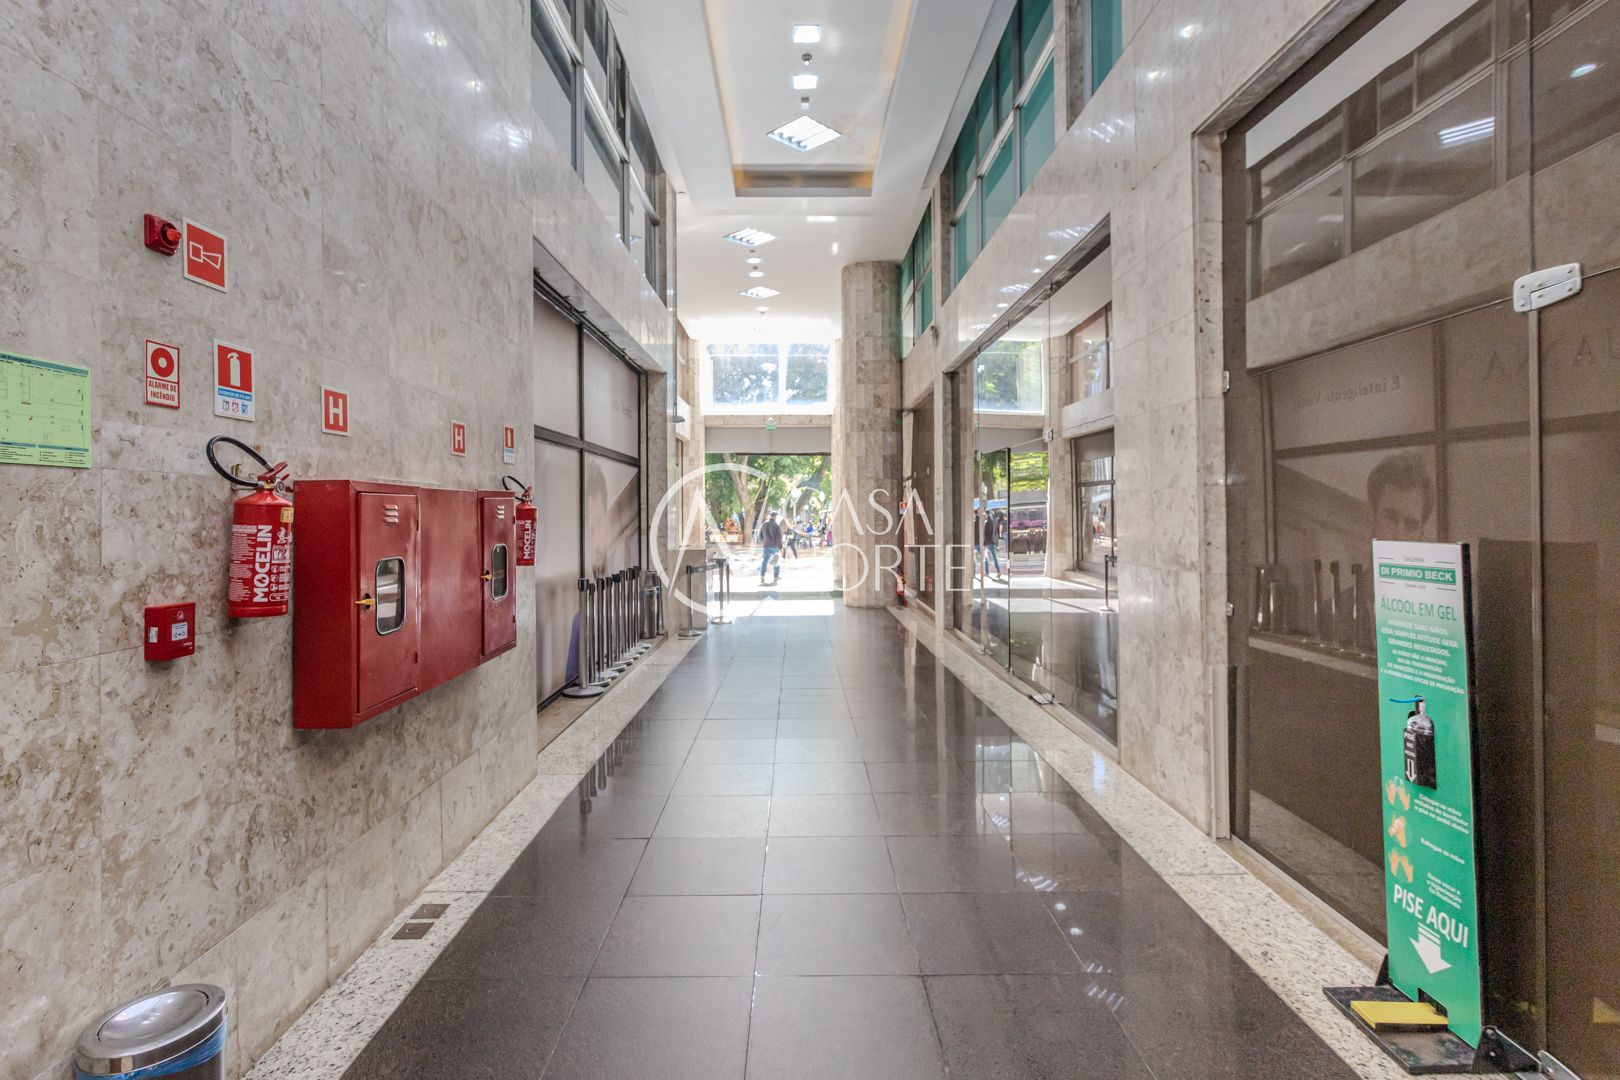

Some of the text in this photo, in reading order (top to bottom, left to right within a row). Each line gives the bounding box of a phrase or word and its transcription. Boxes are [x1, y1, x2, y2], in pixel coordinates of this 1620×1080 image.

[148, 380, 170, 391] ALARME
[150, 390, 176, 402] INCÊNDIO
[329, 396, 343, 427] H
[455, 427, 463, 450] H
[523, 519, 532, 560] MOCELIN
[253, 525, 273, 602] MOCELIN
[1381, 567, 1452, 581] DI PRIMIO BECK
[1381, 594, 1457, 622] ÁLCOOL EM GEL
[1394, 884, 1468, 947] PISE AQUI
